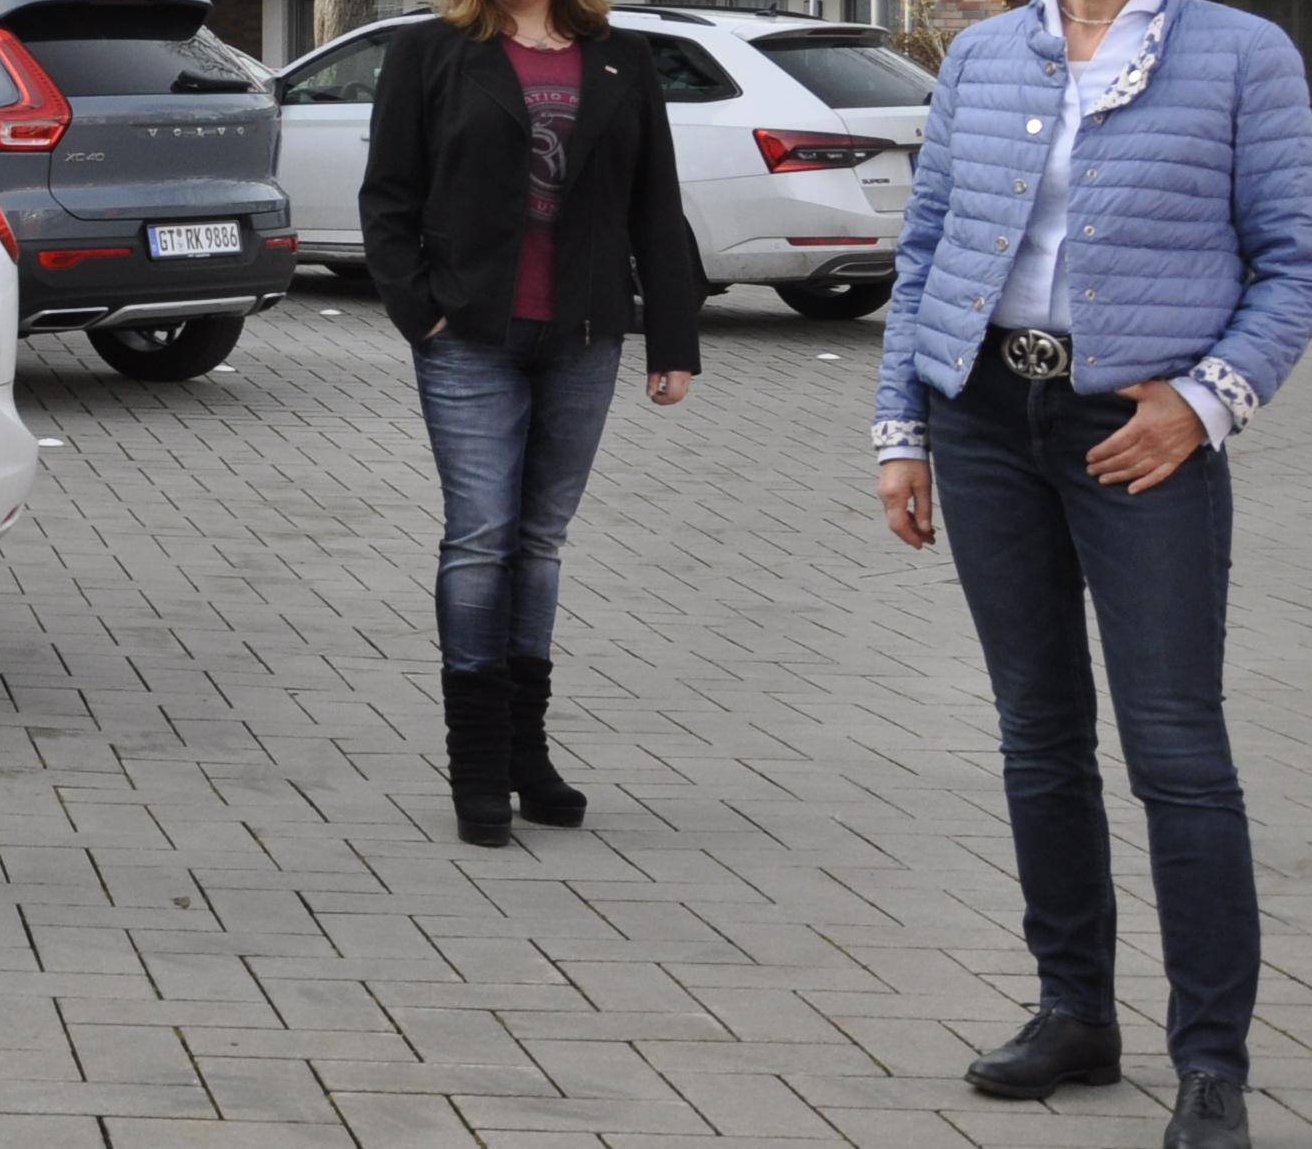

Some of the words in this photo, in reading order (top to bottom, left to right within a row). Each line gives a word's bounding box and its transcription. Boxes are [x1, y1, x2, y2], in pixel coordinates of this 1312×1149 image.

[147, 126, 245, 137] VOLVO
[64, 152, 105, 162] XC40
[158, 229, 176, 251] GT
[185, 227, 204, 250] RK
[205, 225, 239, 249] 9886
